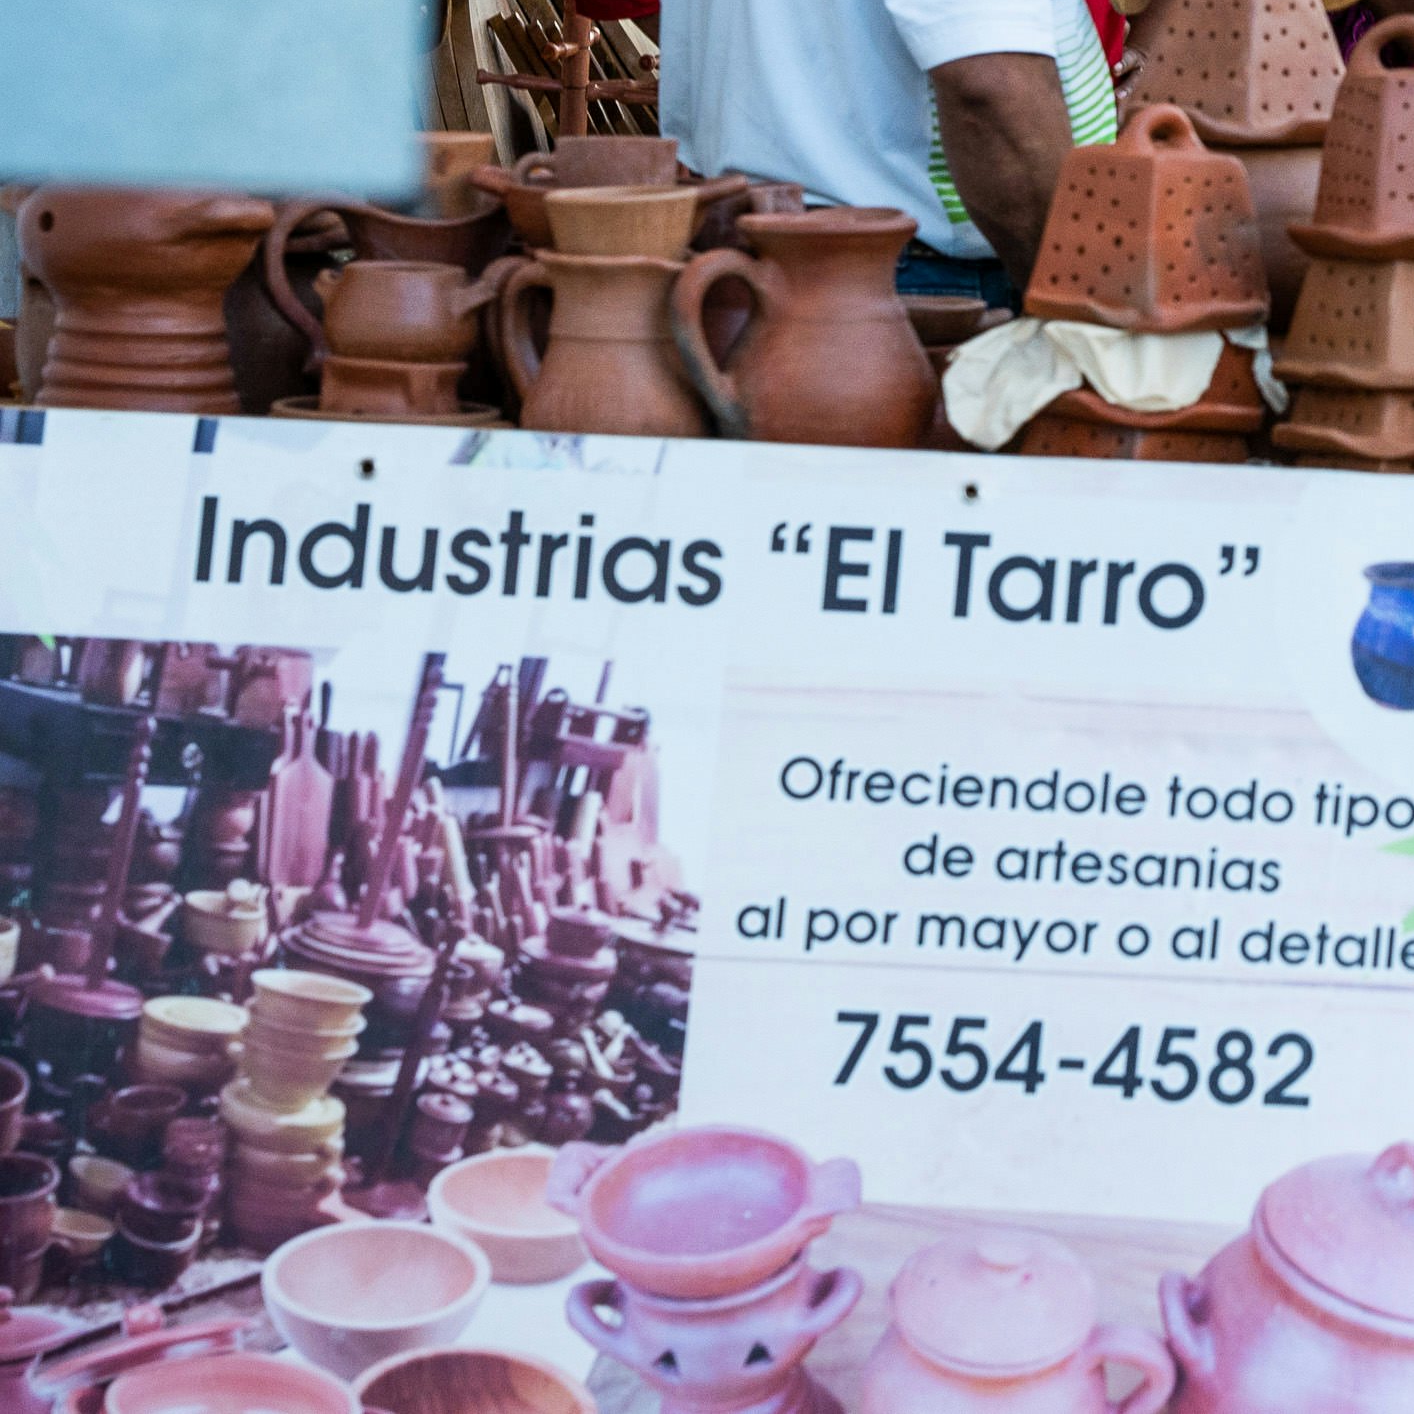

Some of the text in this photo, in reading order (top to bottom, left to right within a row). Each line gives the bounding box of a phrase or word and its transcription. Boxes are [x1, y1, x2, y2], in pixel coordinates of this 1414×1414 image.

[194, 495, 1260, 631] Industrias “El Tarro”
[779, 756, 1147, 817] Ofreciendole
[1168, 775, 1295, 824] todo
[902, 833, 1282, 894] de artesanias
[736, 896, 787, 940] al
[804, 908, 900, 953] por
[916, 913, 1098, 962] mayor
[1117, 923, 1152, 959] o
[1170, 917, 1221, 962] al
[833, 1010, 1314, 1108] 7554-4582
